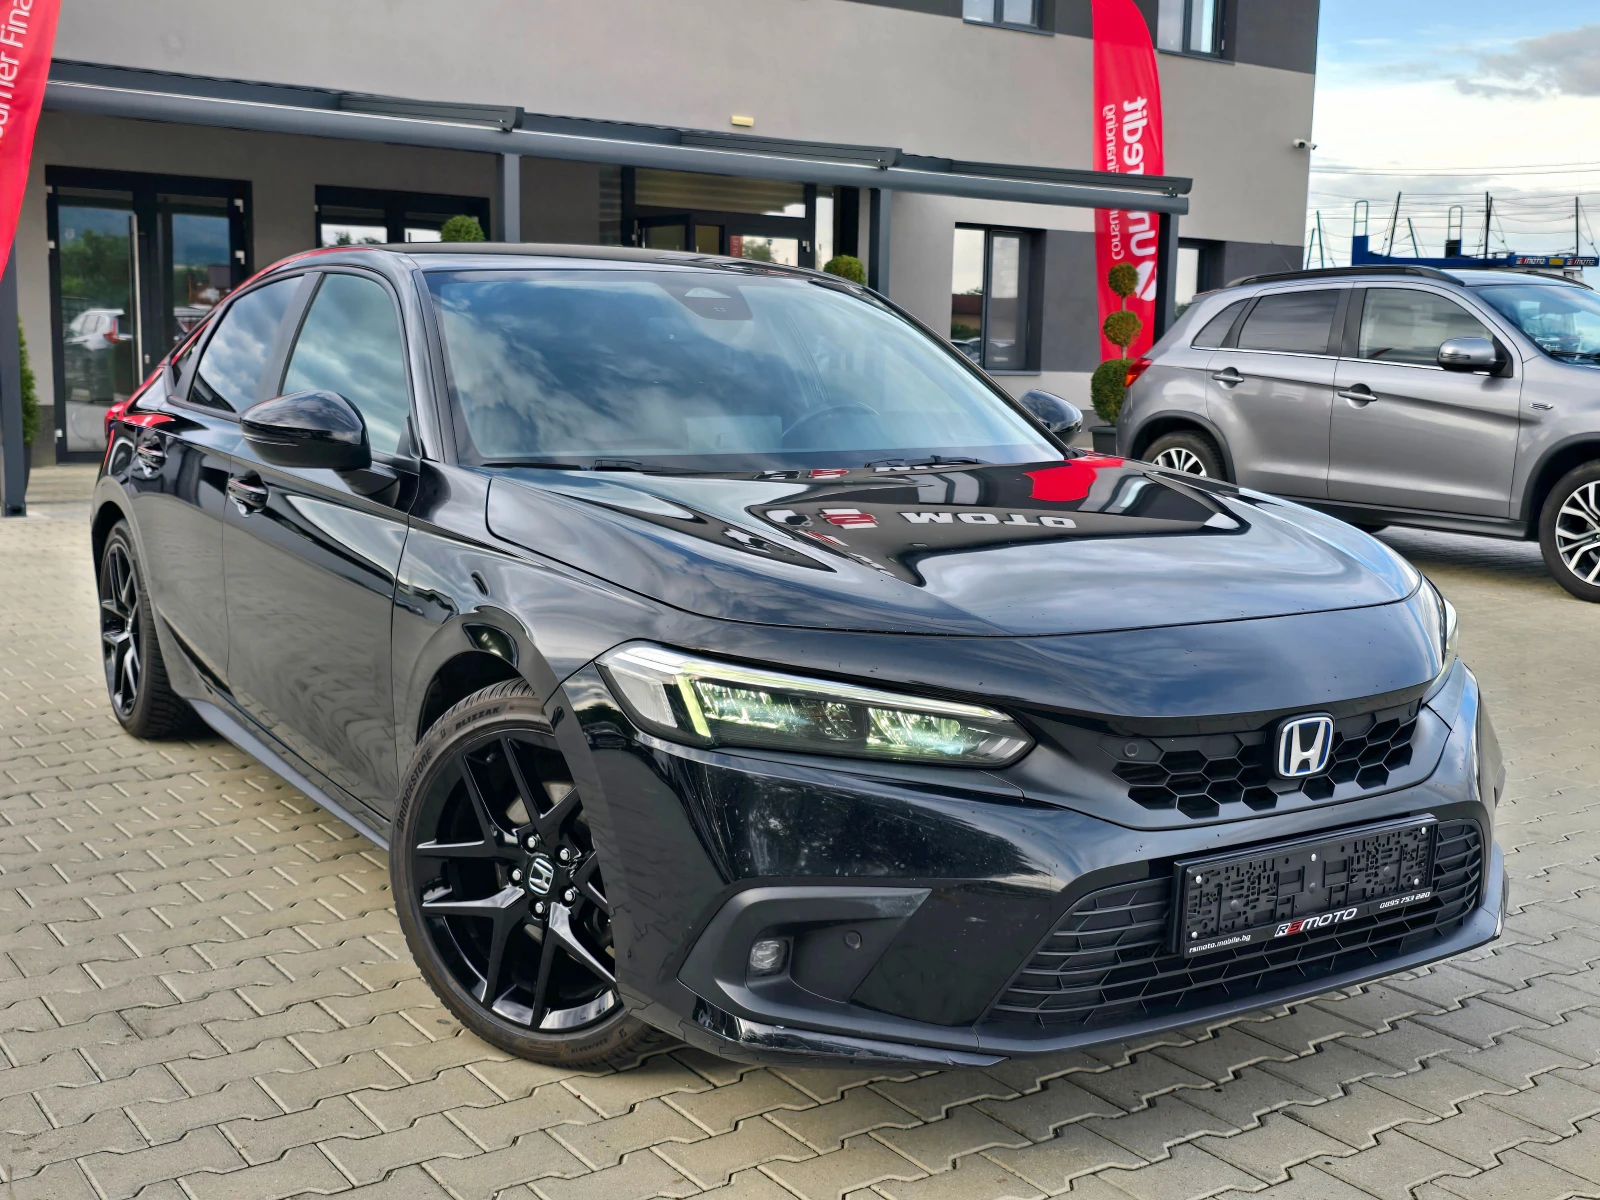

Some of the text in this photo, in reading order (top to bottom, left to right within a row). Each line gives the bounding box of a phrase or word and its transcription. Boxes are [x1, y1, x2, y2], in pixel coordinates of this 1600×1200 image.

[455, 706, 500, 731] BLIZZAK
[397, 748, 433, 832] BRIDGESTONE
[1379, 898, 1400, 909] 0895
[1400, 894, 1415, 904] 753
[1274, 908, 1357, 937] RSMOTO
[1189, 934, 1251, 953] rsmoto.mobile.bg
